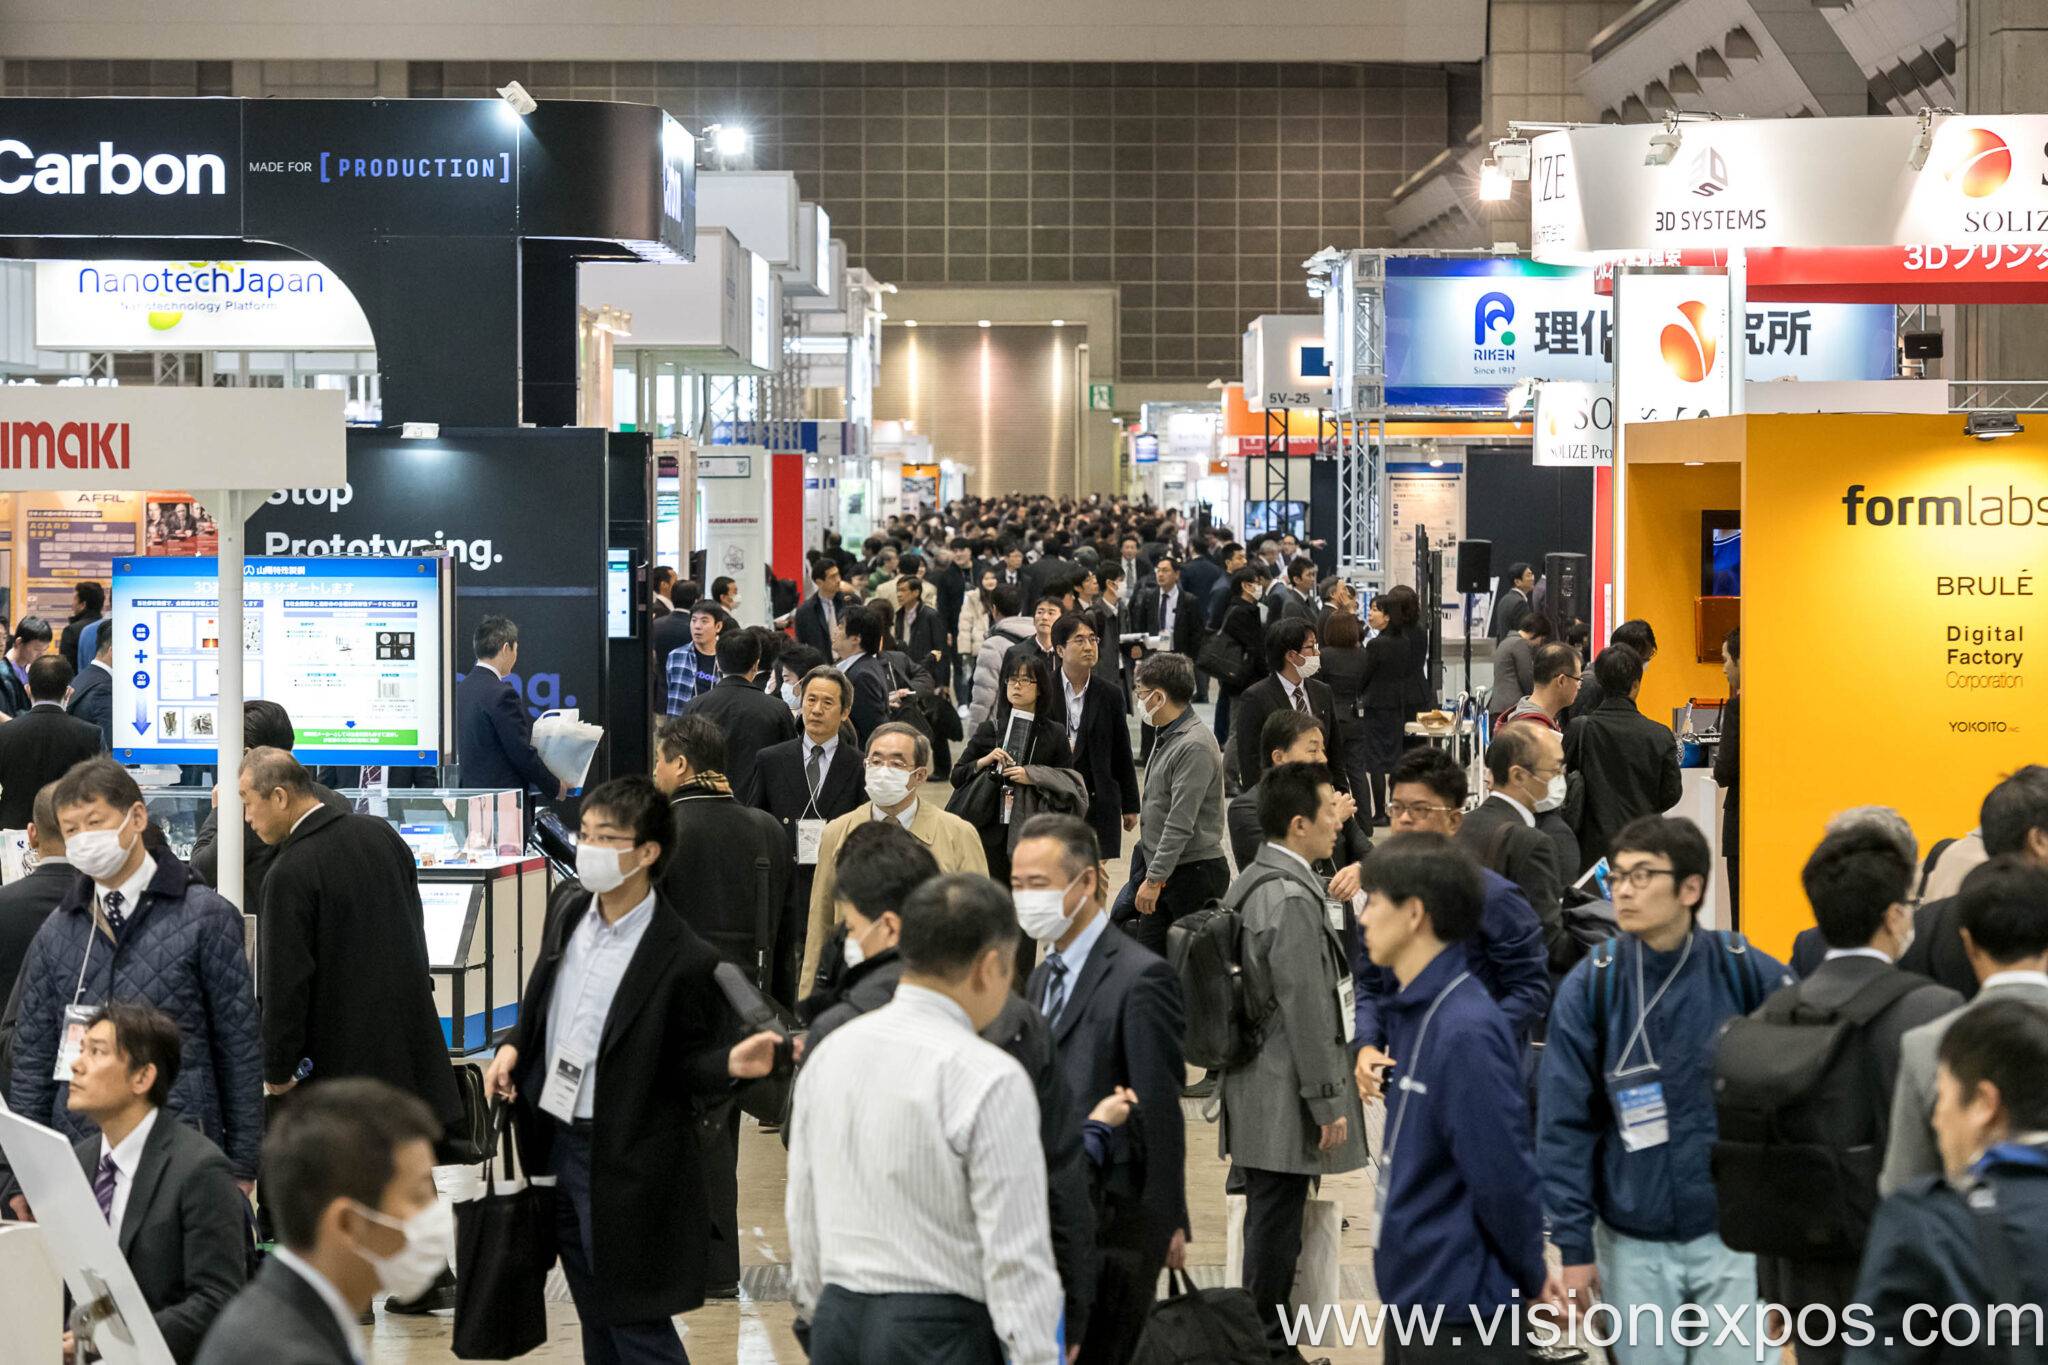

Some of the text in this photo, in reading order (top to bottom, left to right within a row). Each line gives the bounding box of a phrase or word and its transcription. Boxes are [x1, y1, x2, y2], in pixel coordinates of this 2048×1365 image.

[0, 139, 226, 195] Carbon
[249, 162, 284, 172] MADE
[288, 162, 312, 172] FOR
[1656, 209, 1766, 232] 3D SYSTEMS
[1474, 349, 1515, 361] RIKEN
[1474, 366, 1516, 375] Since 1917
[1269, 392, 1311, 404] 5V-25
[1936, 568, 2034, 596] BRULÉ
[1947, 625, 2023, 646] Digital
[1947, 648, 2023, 668] Factory
[1946, 671, 2024, 691] Corporation
[1949, 721, 2007, 733] YOKOITO
